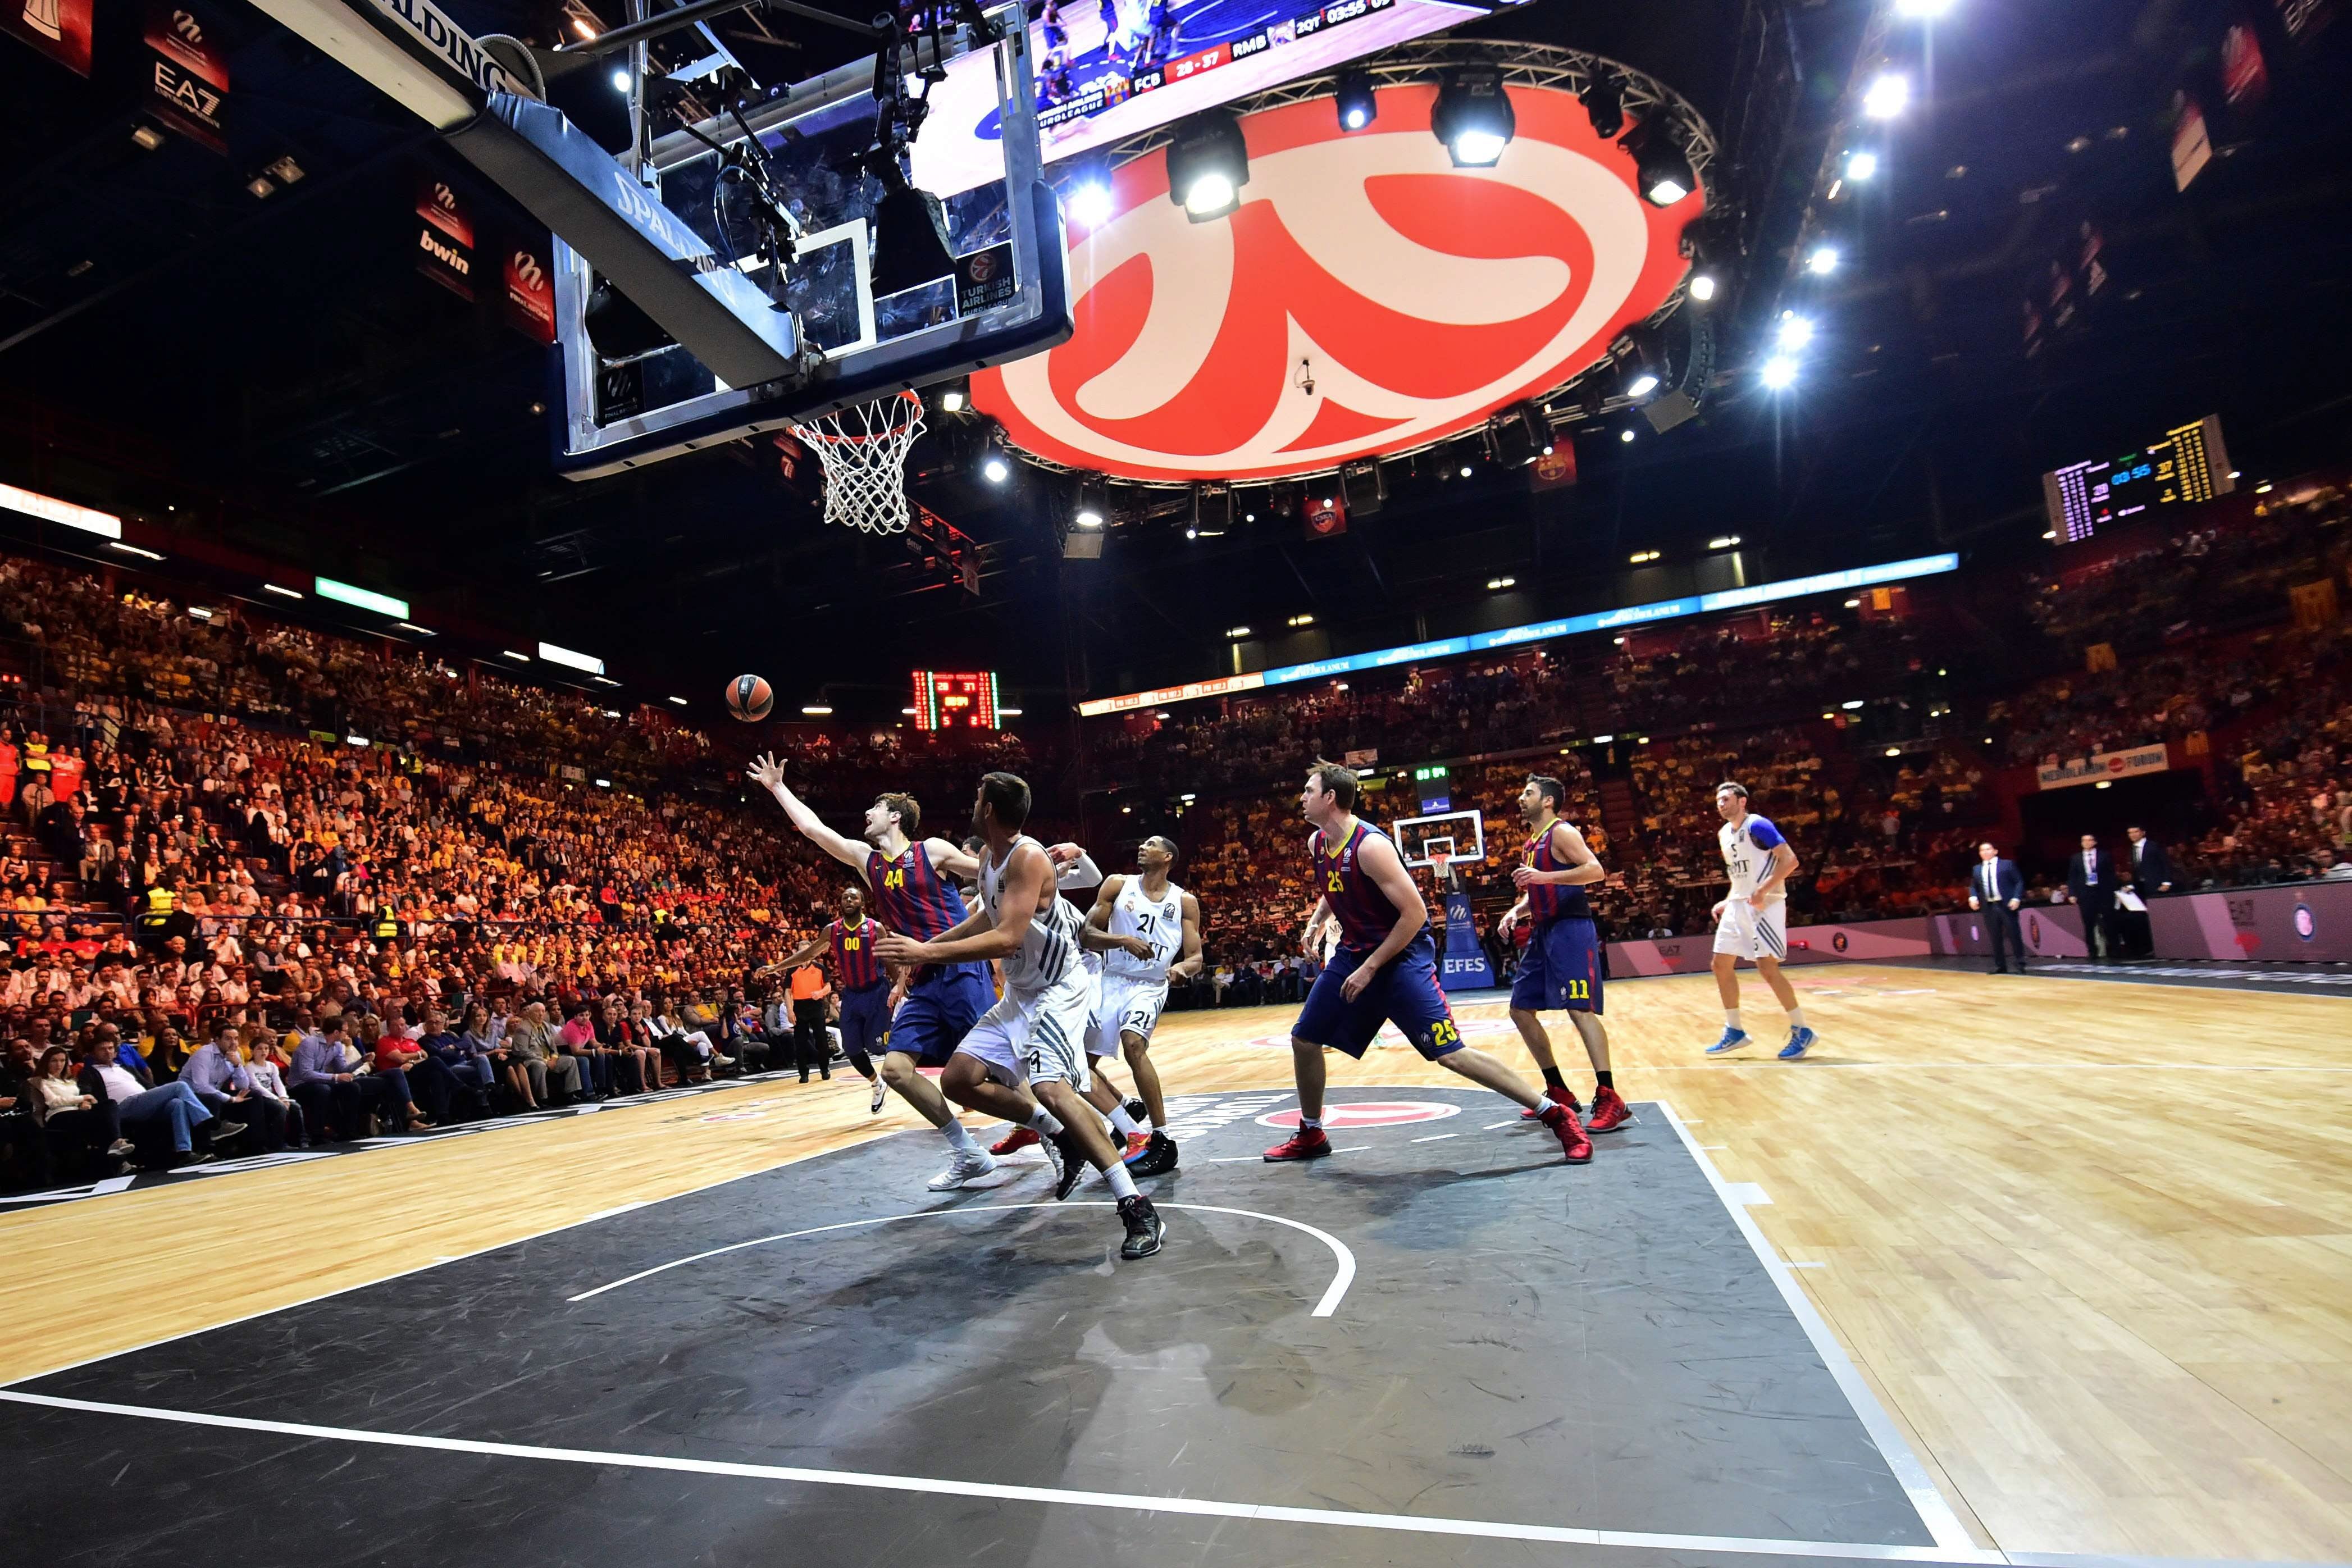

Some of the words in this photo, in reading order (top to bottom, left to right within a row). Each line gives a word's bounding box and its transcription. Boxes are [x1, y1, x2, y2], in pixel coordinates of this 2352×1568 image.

[383, 0, 507, 91] LDING
[1134, 72, 1161, 93] FCB
[1201, 51, 1219, 66] 37
[1233, 35, 1267, 57] RMB
[1296, 15, 1321, 34] 2QT
[155, 61, 221, 116] EA7
[1039, 99, 1104, 127] UROLEAGUE
[614, 171, 740, 307] SPALDING
[420, 229, 470, 275] bwin
[961, 276, 1011, 300] TURKISH
[961, 286, 1012, 310] AIRLINES
[937, 682, 949, 691] 28
[964, 682, 976, 691] 37
[884, 868, 904, 890] 44
[1327, 870, 1344, 892] 25
[1136, 913, 1156, 935] 21
[844, 937, 860, 951] 00
[1443, 957, 1485, 974] EFES
[1569, 979, 1590, 1000] 11
[1130, 1010, 1151, 1029] 21
[883, 1031, 890, 1045] 0
[1431, 1019, 1458, 1046] 25
[1029, 1050, 1041, 1073] 9
[1167, 1093, 1296, 1143] TURKIS
